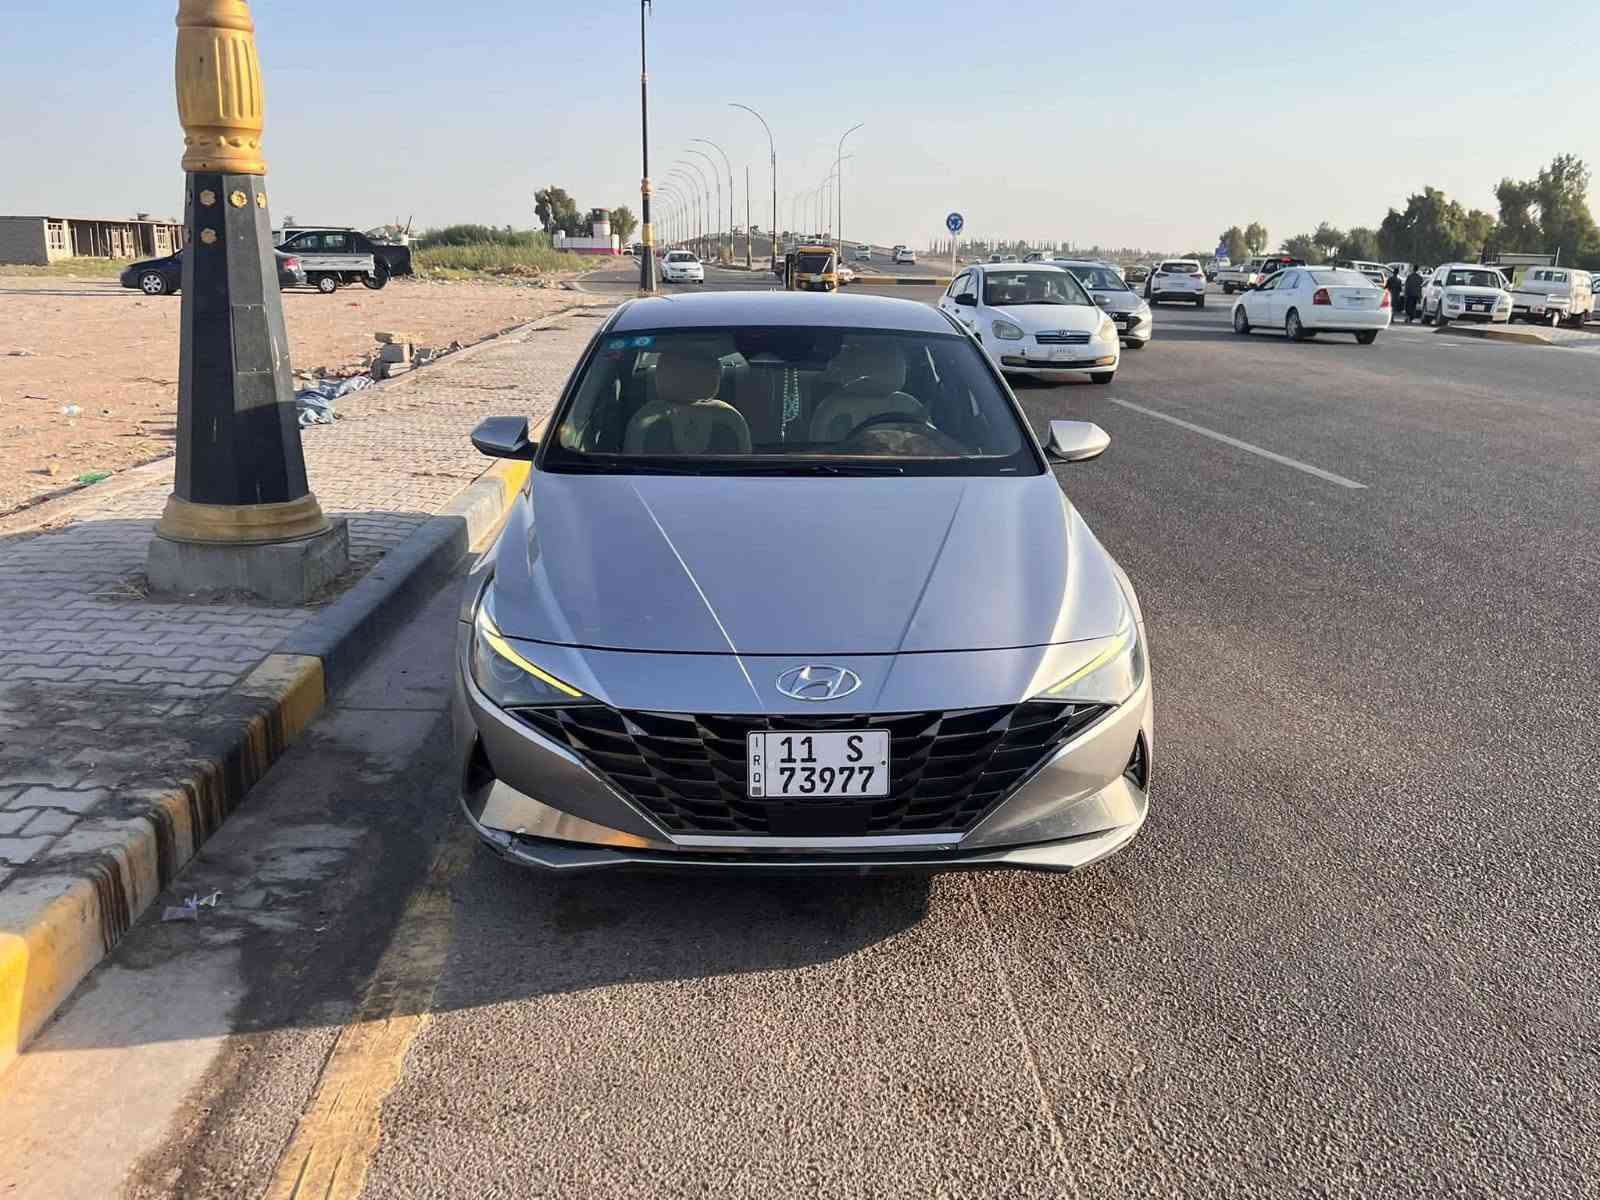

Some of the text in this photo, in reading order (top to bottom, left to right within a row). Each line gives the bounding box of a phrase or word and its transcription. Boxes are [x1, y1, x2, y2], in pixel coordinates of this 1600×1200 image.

[780, 735, 864, 763] 11 S
[779, 766, 875, 793] 73977
